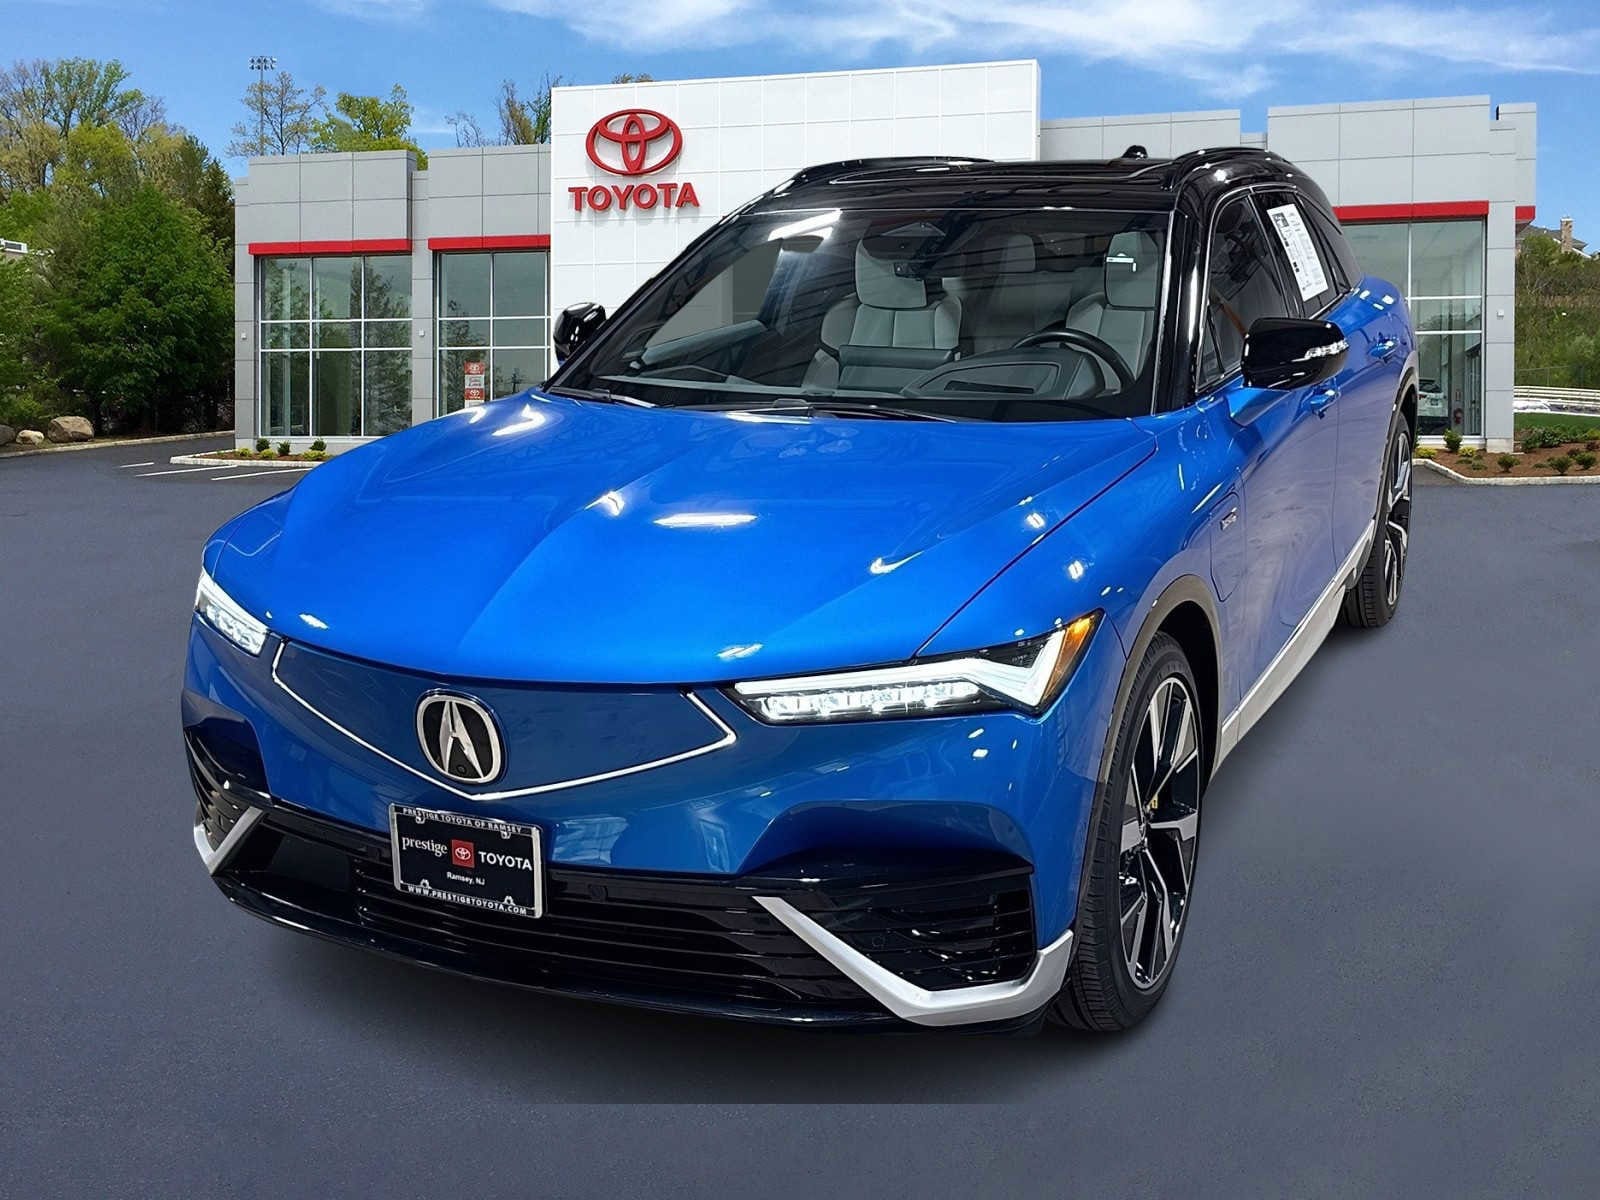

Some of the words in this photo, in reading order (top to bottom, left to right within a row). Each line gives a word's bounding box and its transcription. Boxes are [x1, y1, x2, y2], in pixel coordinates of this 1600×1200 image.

[568, 182, 700, 211] TOYOTA
[441, 815, 473, 827] TOYOTA
[474, 819, 486, 829] OF
[488, 822, 522, 834] RAMSEY
[401, 836, 448, 857] prestige
[478, 851, 532, 871] TOYOTA
[446, 871, 474, 885] Ramsey,
[475, 876, 485, 886] NJ
